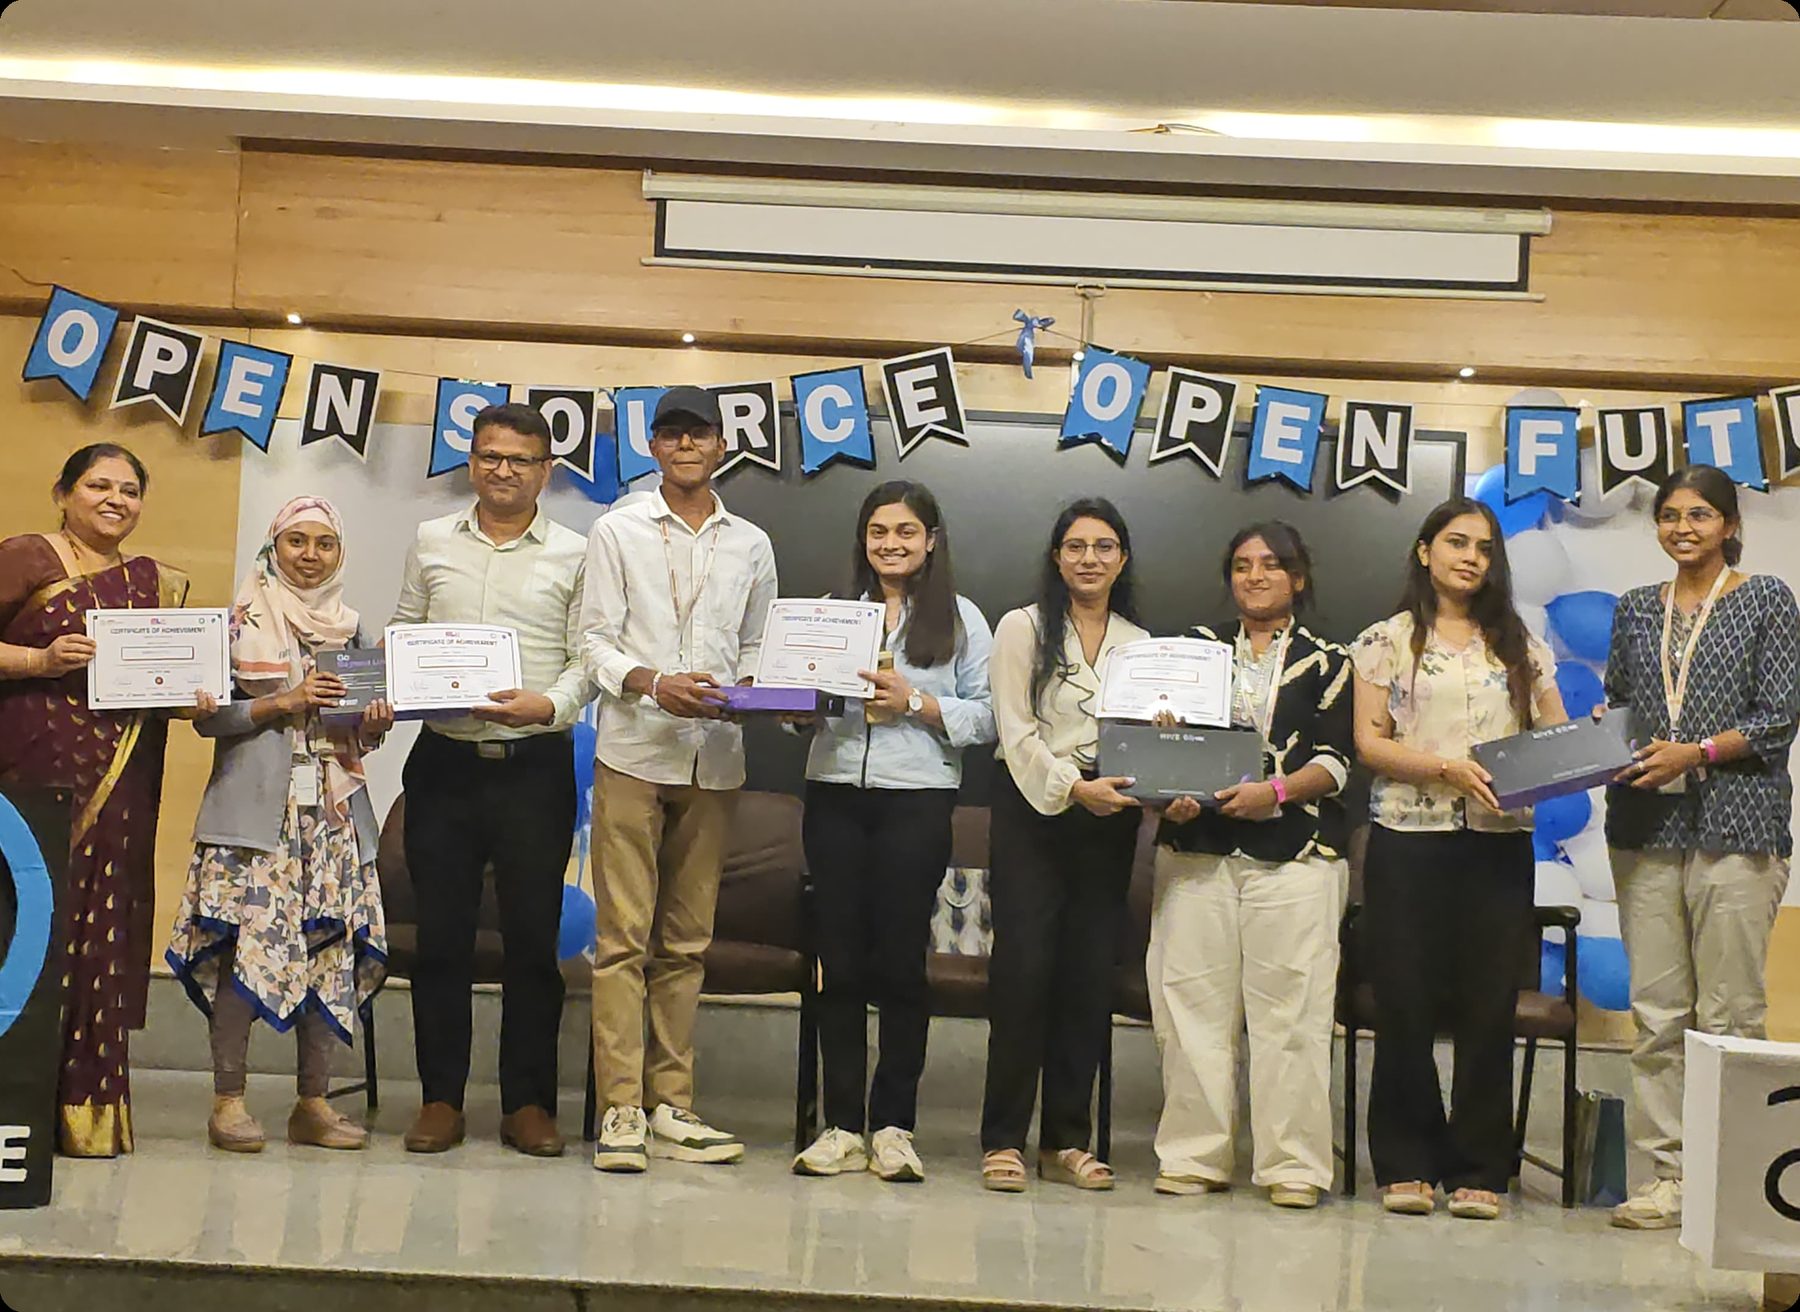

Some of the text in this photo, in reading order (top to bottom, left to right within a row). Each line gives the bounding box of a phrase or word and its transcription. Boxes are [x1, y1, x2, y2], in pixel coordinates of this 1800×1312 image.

[48, 309, 365, 435] OPEN
[1082, 362, 1800, 475] OPEN FUT
